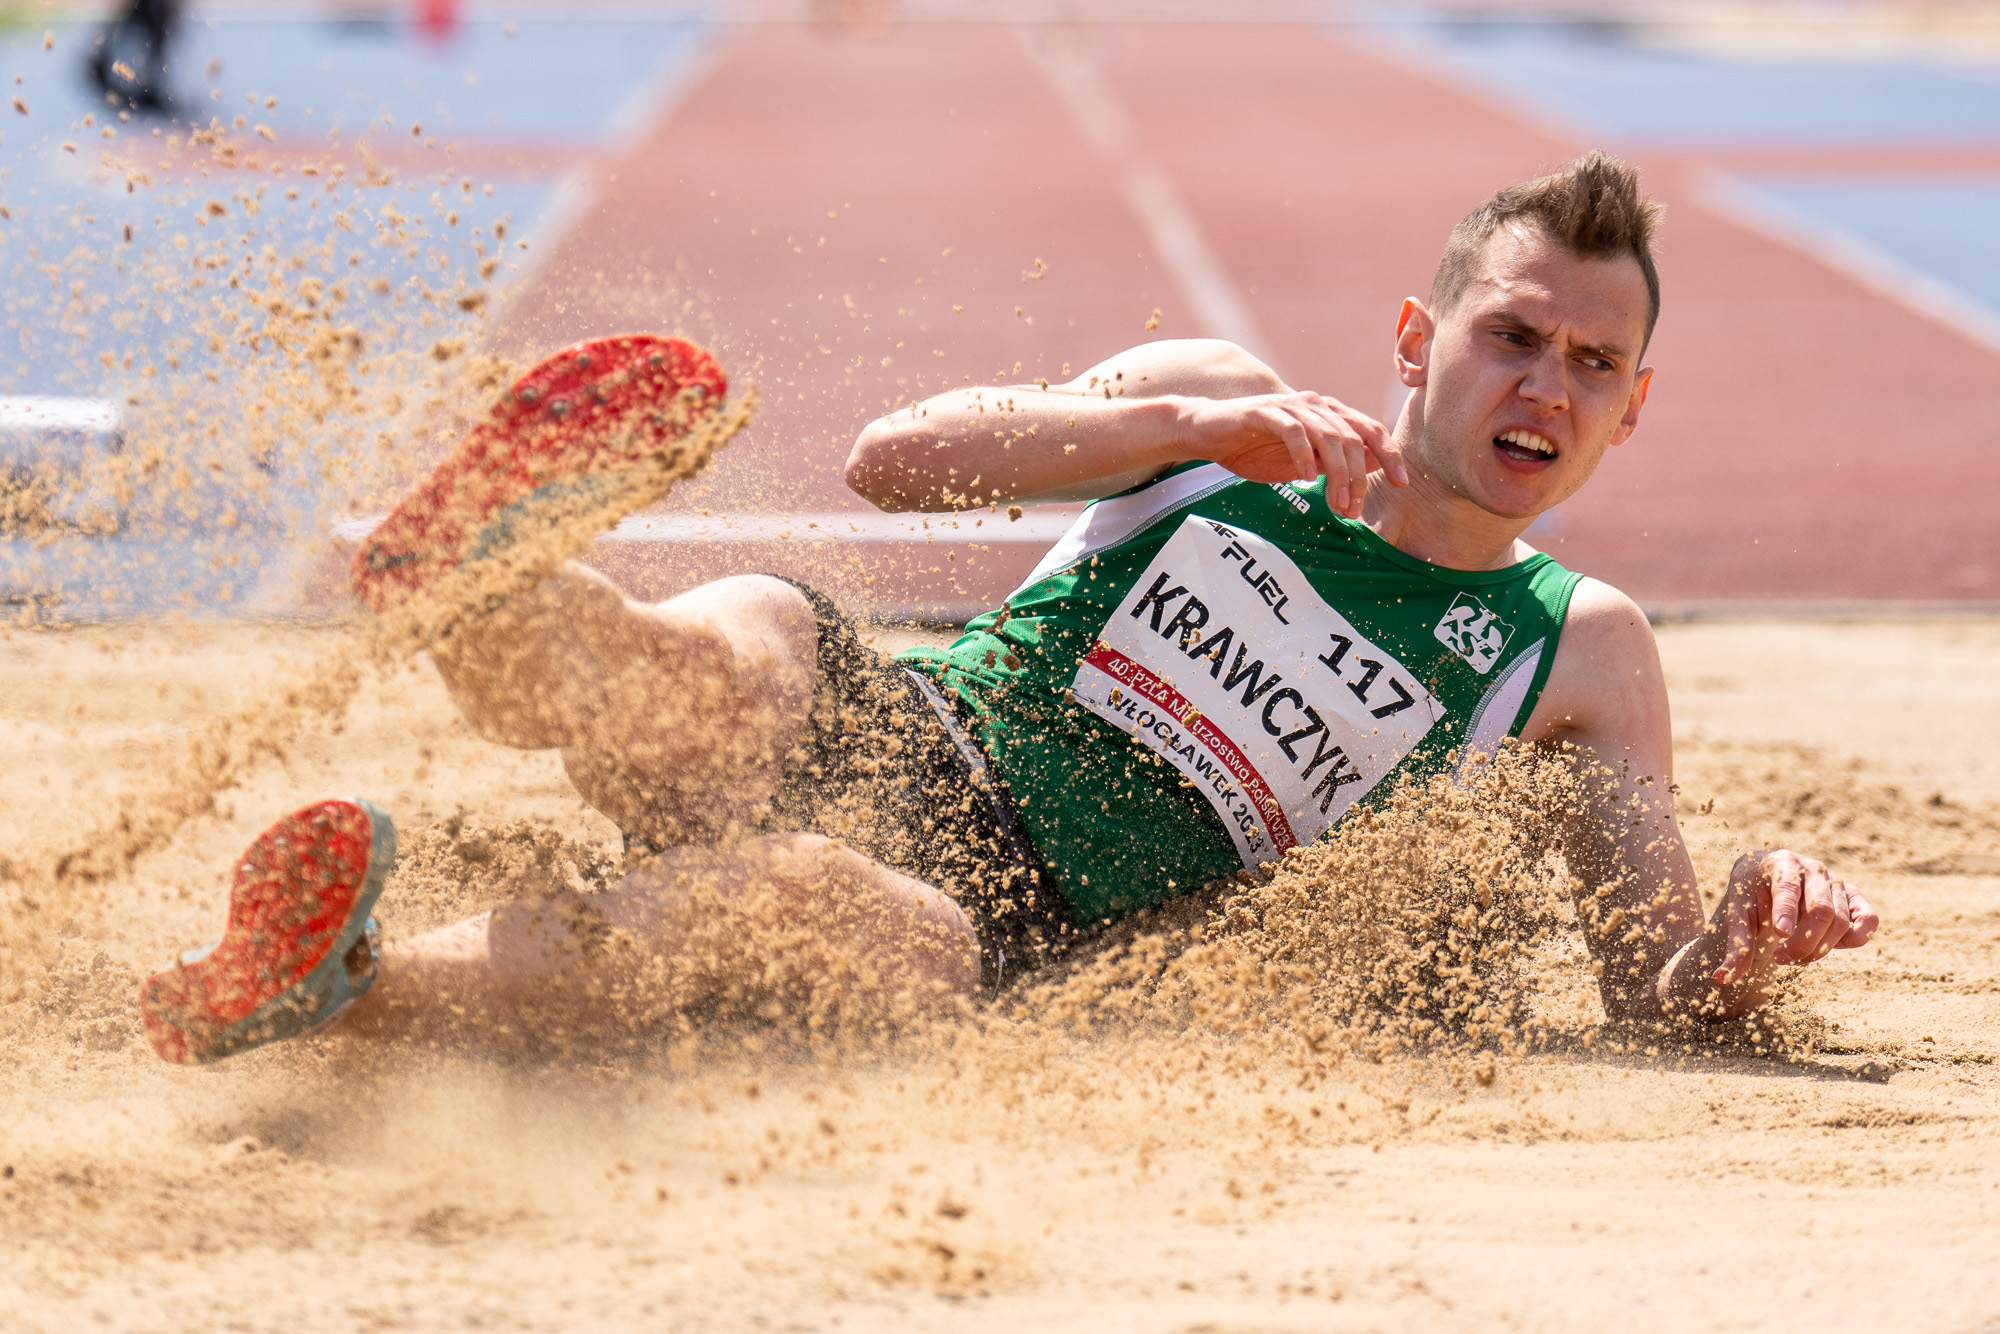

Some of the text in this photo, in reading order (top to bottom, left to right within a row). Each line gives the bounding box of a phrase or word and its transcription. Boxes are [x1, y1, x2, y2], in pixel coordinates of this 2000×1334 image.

[1268, 482, 1311, 515] rima
[1220, 541, 1290, 626] FUEL
[1129, 571, 1362, 815] KRAWCZYK
[1317, 633, 1416, 719] 117
[1131, 671, 1167, 703] PZLA
[1168, 698, 1249, 781] Mitrzostwa
[1248, 778, 1278, 822] Polski
[1272, 818, 1290, 848] U23
